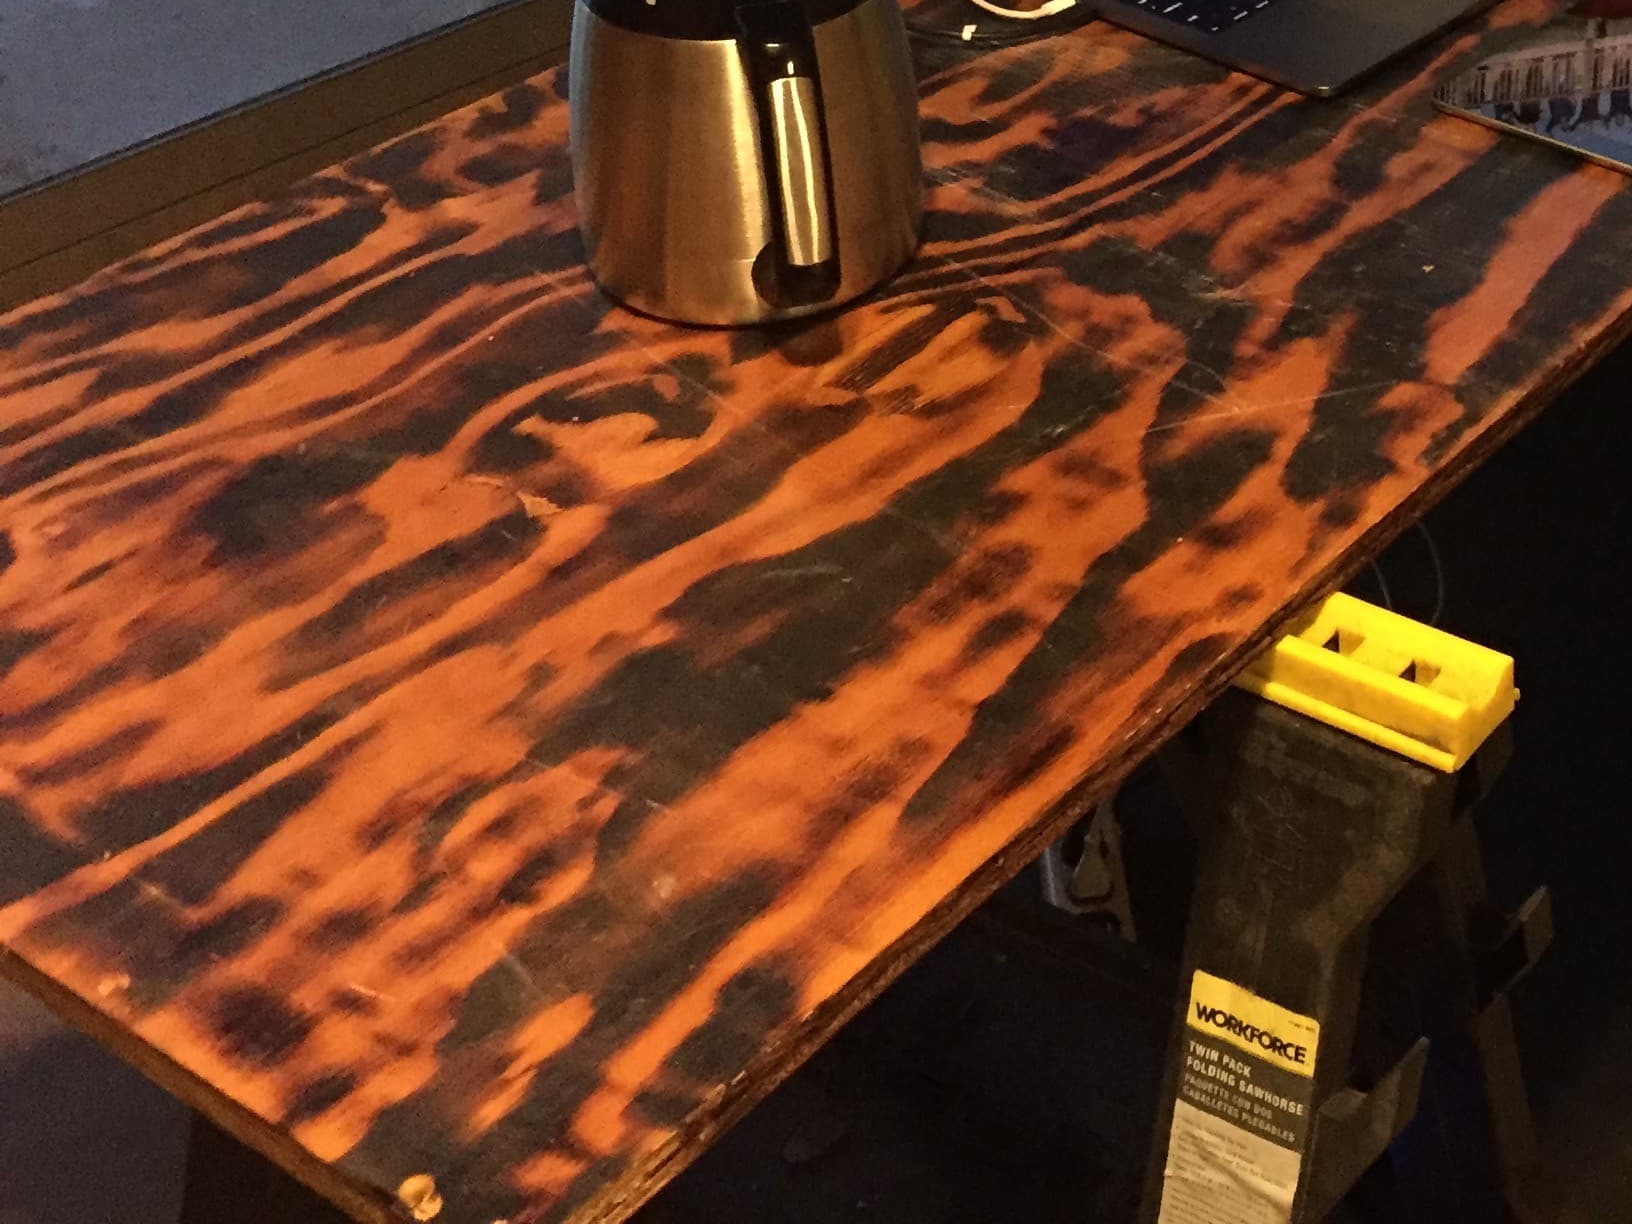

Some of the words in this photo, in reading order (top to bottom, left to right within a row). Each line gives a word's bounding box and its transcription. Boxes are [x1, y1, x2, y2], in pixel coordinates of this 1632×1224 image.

[1189, 1040, 1219, 1062] TWIN
[1222, 1054, 1252, 1078] PACK
[1195, 1001, 1307, 1064] WORKFORCE
[1186, 1055, 1236, 1087] FOLDING
[1238, 1079, 1304, 1116] SAWHORSE
